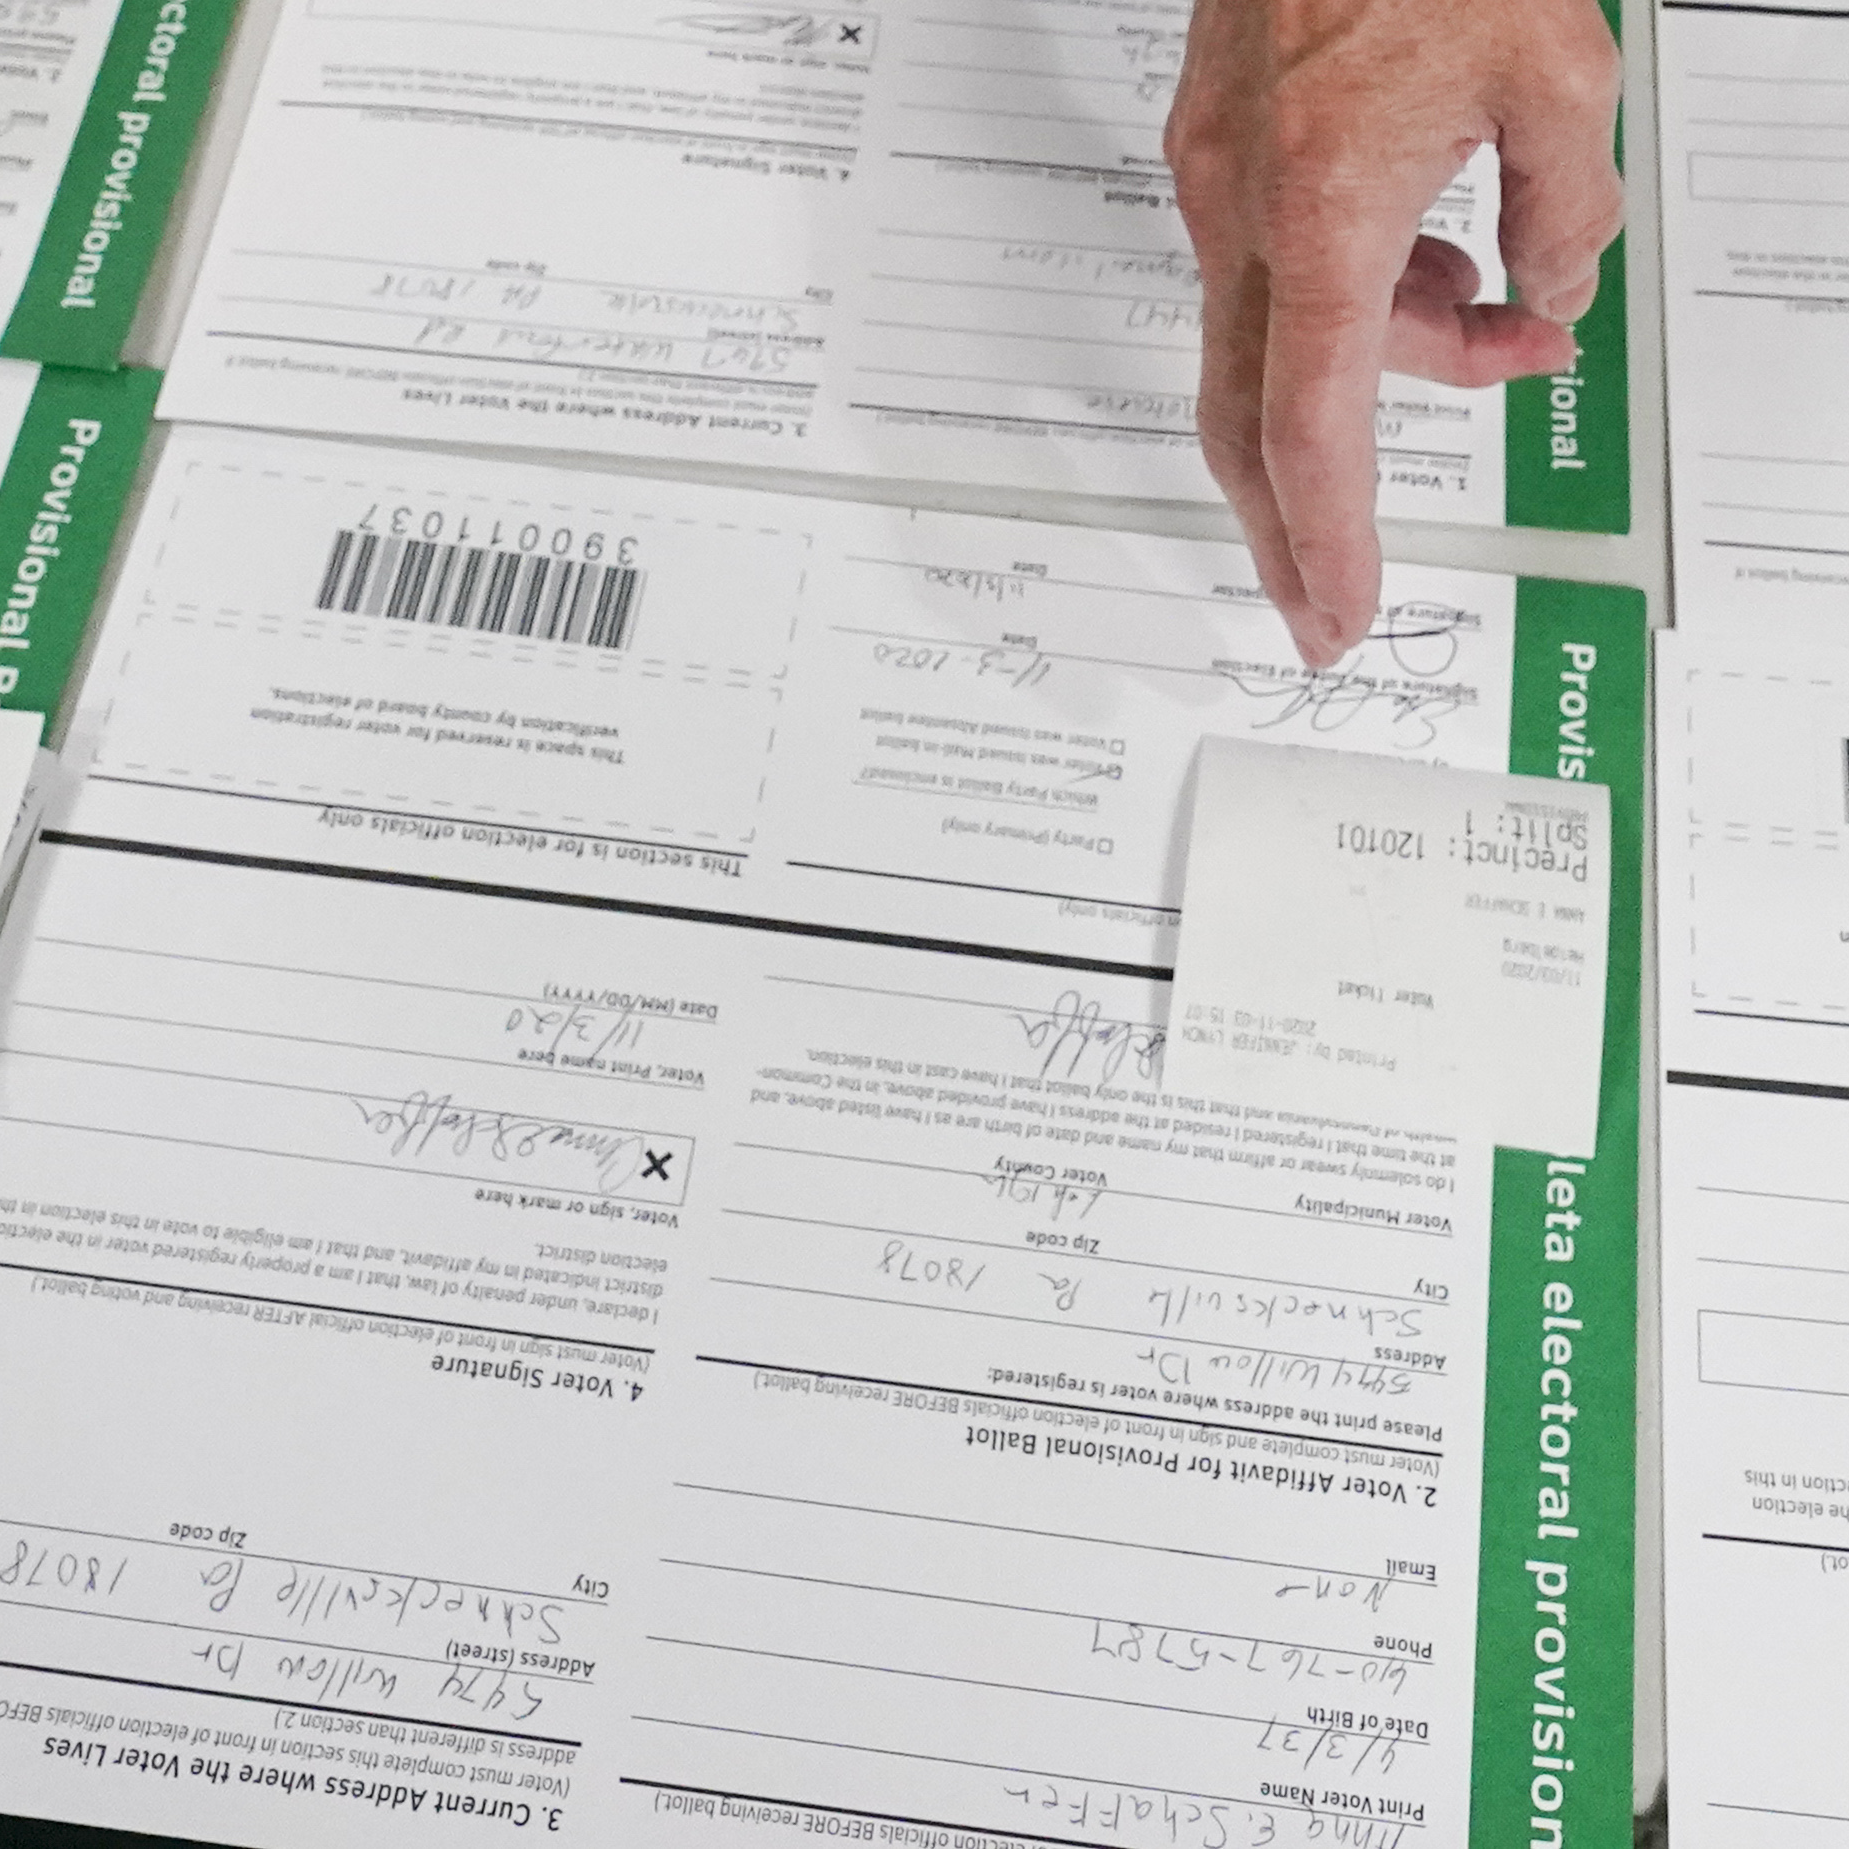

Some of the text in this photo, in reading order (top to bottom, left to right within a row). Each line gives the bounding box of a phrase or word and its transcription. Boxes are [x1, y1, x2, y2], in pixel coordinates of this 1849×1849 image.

[59, 109, 152, 309] provisional
[356, 502, 639, 565] 390011037
[1464, 808, 1588, 851] Split: 1
[1336, 821, 1588, 883] Precinct: 120101
[992, 1154, 1108, 1187] Voter County
[1293, 1192, 1453, 1233] Voter Municipality
[1543, 1150, 1593, 1262] leta
[1024, 1230, 1101, 1255] Zip code
[1412, 1276, 1449, 1300] City
[430, 1354, 644, 1402] 4. Voter Signature
[1373, 1345, 1447, 1371] Address
[1536, 1280, 1583, 1540] electoral
[964, 1424, 1437, 1508] 2. Voter Affidavit for Provisional Ballot
[1385, 1557, 1436, 1582] Email
[444, 1637, 596, 1678] Address (street)
[1372, 1634, 1433, 1659] Phone
[1306, 1705, 1429, 1740] Date of Birth
[41, 1736, 564, 1832] 3. Current Address where the Voter Lives
[1259, 1781, 1425, 1822] Print Voter Name
